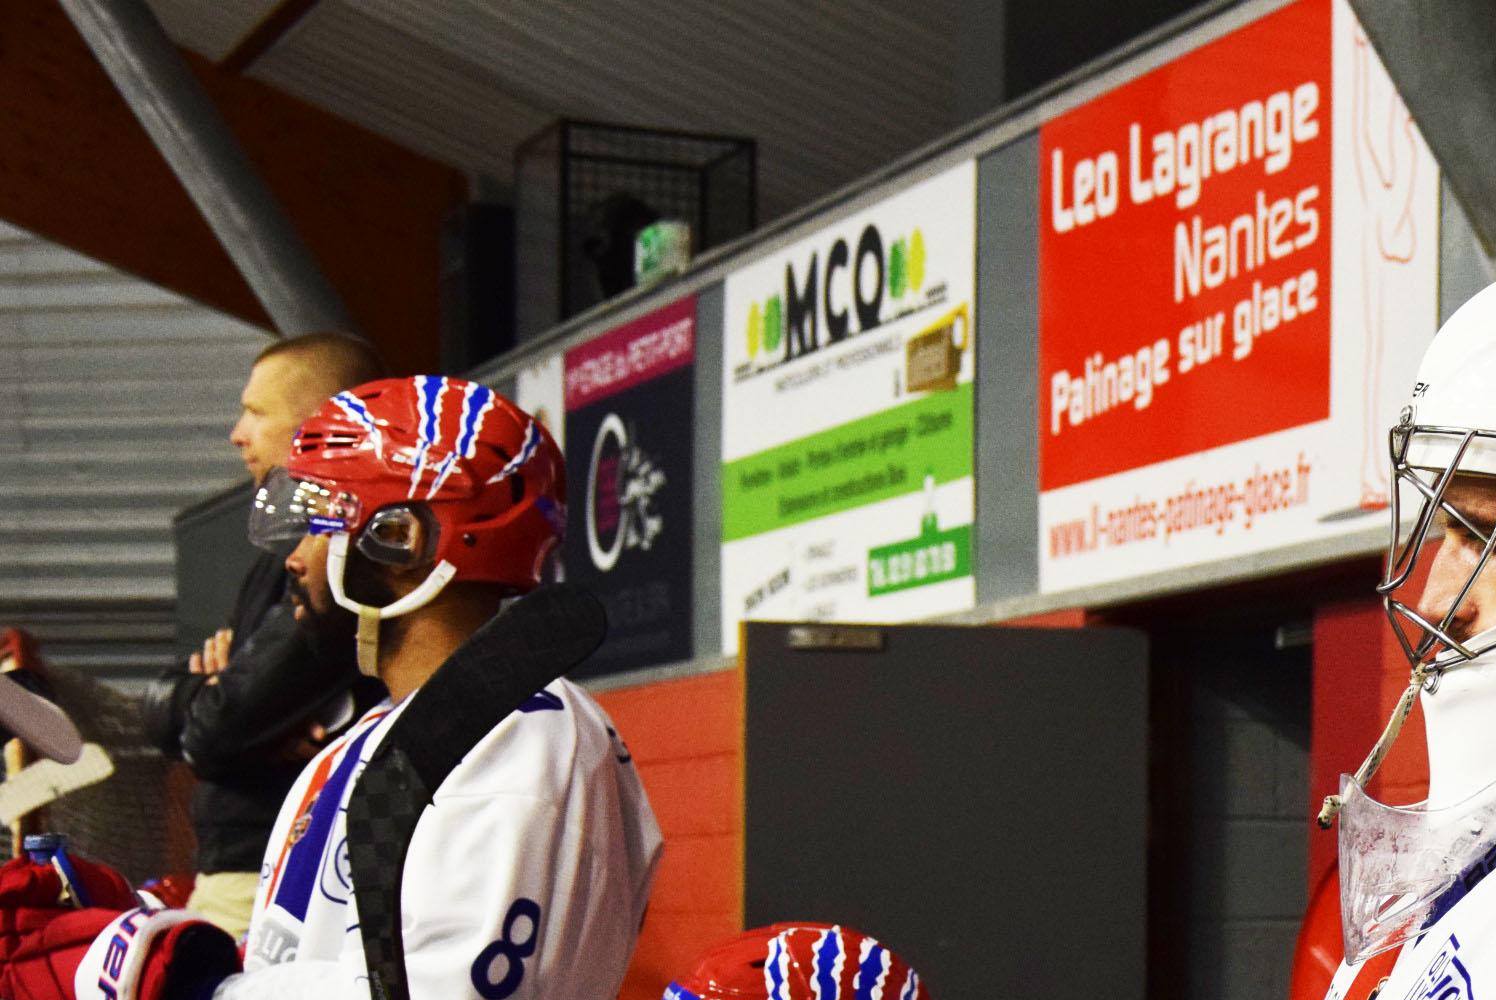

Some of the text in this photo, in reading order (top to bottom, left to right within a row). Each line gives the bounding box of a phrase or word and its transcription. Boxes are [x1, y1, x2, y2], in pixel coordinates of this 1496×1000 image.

[1052, 81, 1320, 233] Leo Lagrange
[1174, 185, 1320, 304] Nantes
[1051, 338, 1170, 435] Patinage
[1178, 312, 1224, 373] sur
[1232, 269, 1319, 361] glace
